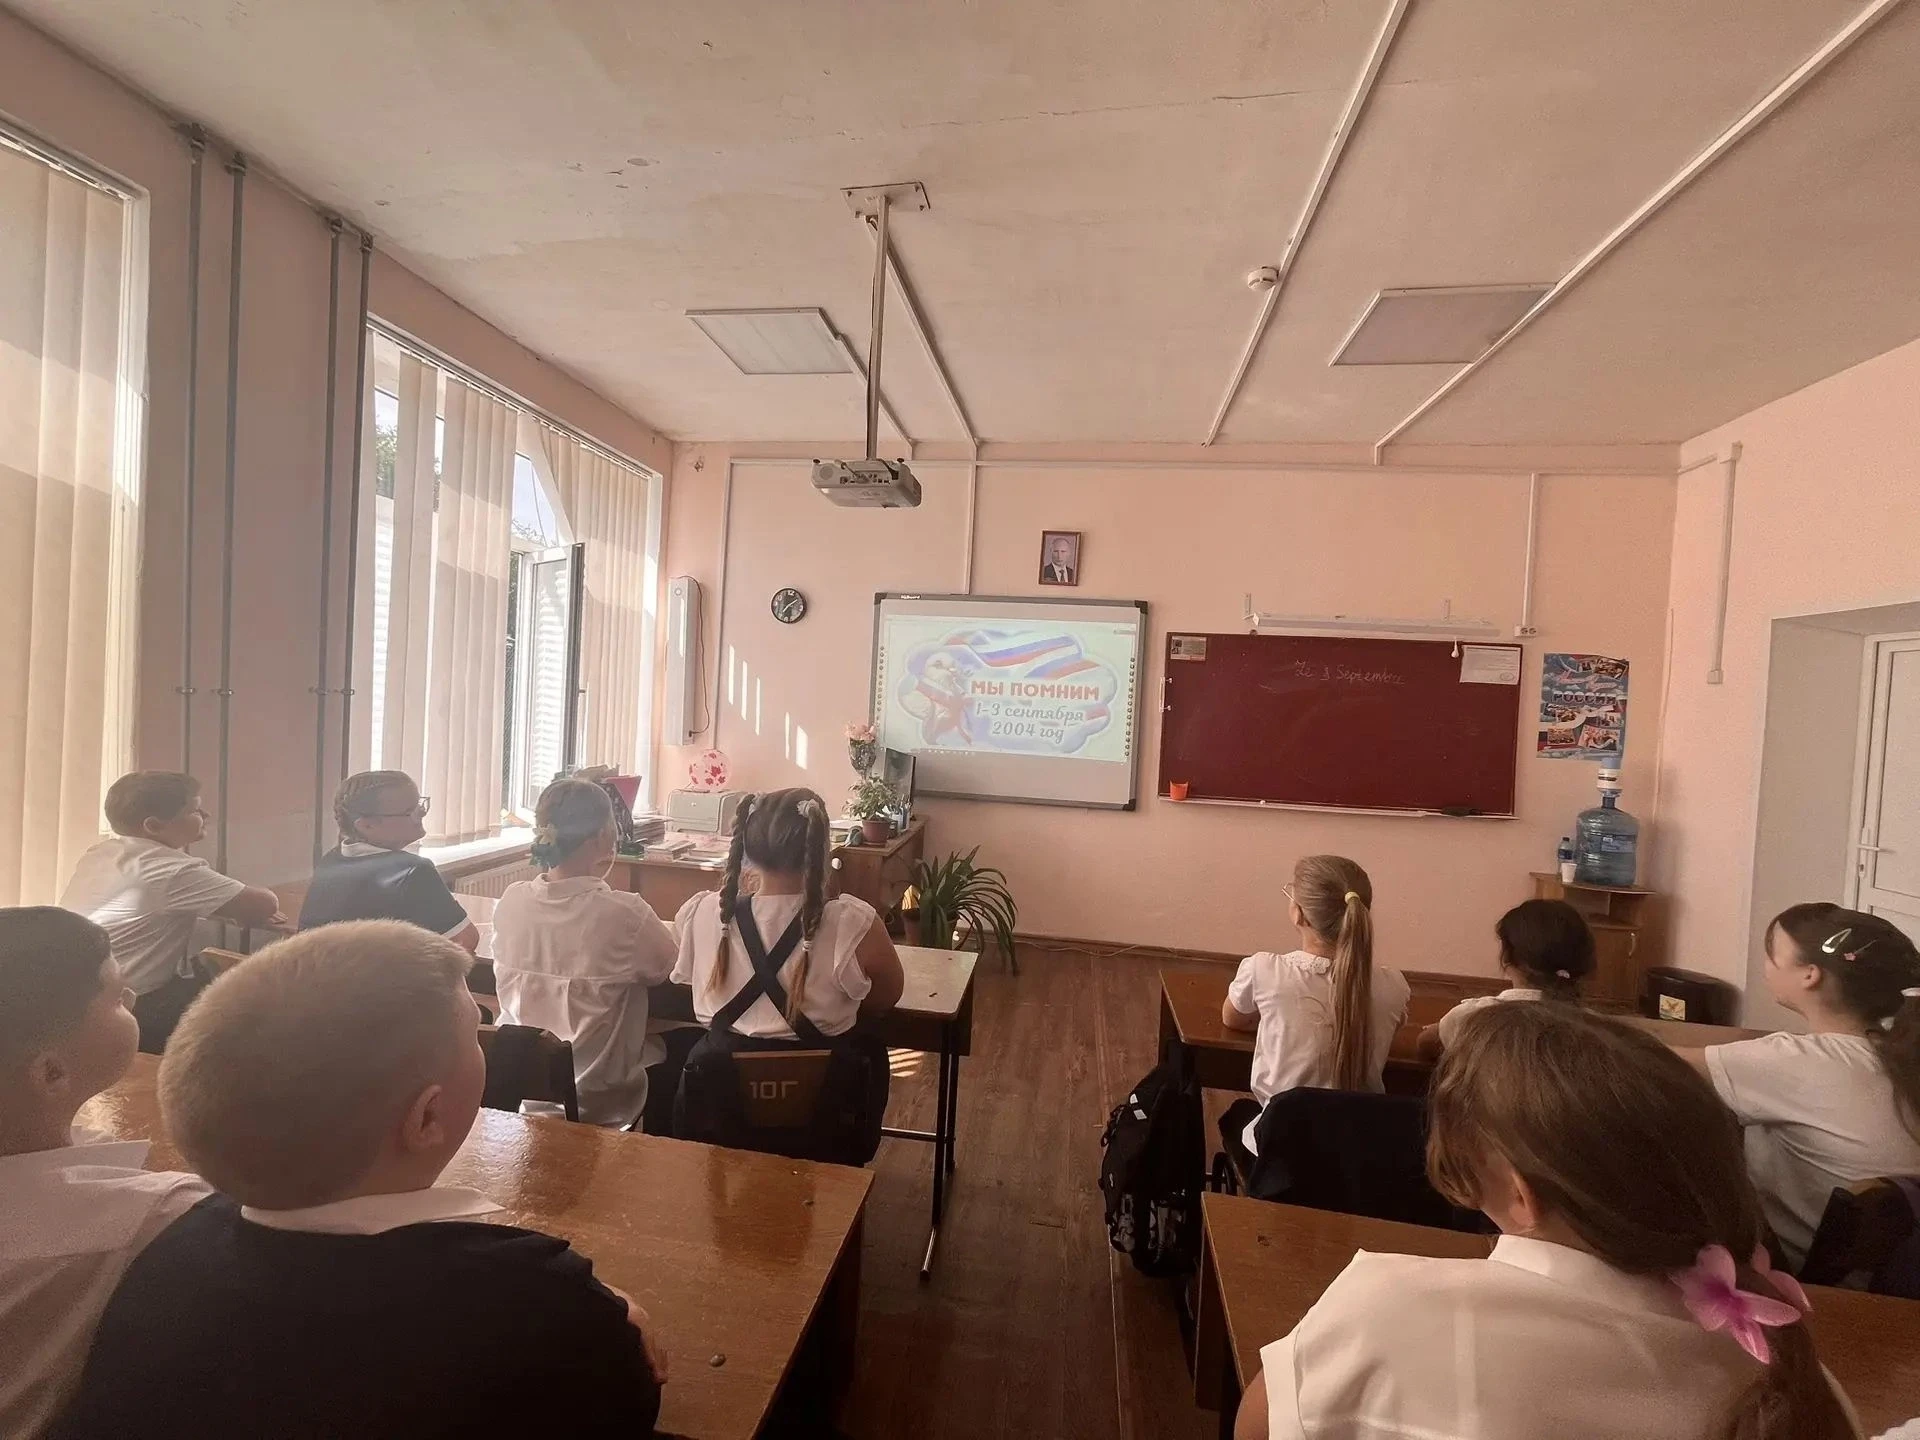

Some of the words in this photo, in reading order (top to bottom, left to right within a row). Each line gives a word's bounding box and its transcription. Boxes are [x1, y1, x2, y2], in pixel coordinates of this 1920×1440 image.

[971, 680, 1004, 696] МЫ
[1010, 682, 1100, 701] ПОМНИМ
[1004, 705, 1084, 727] сентября
[992, 721, 1036, 737] 2004
[1039, 727, 1065, 745] год
